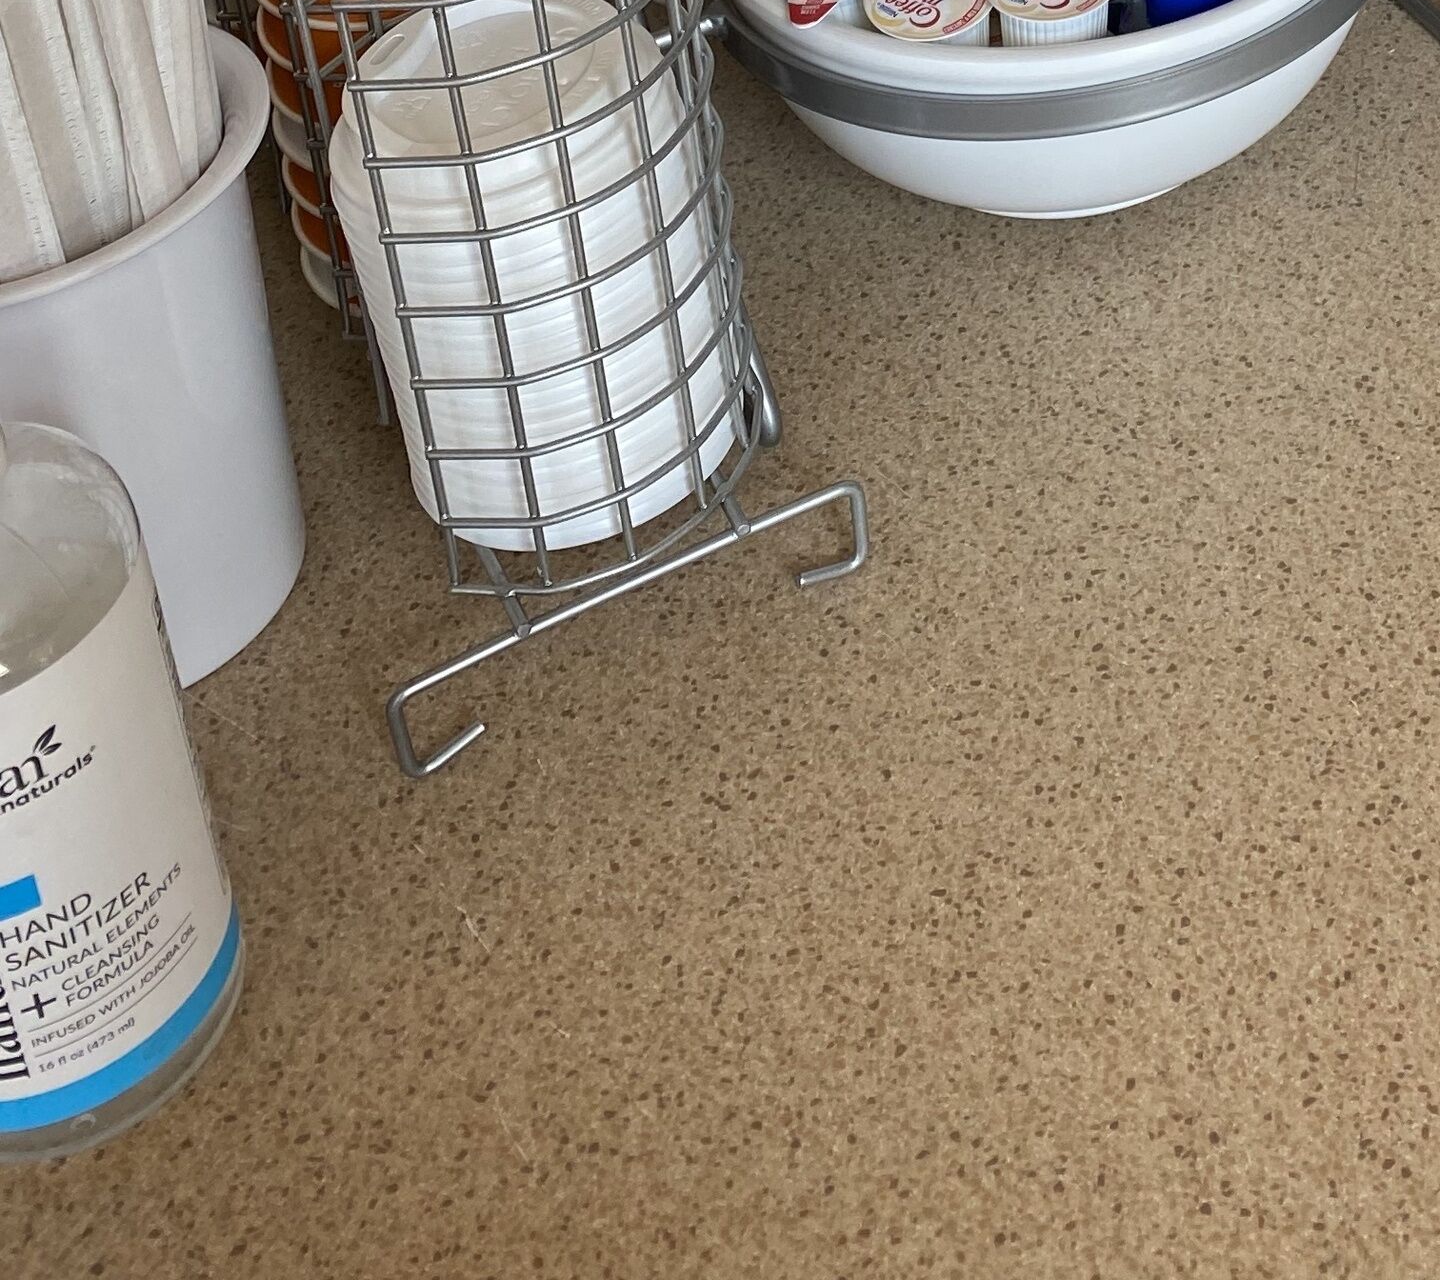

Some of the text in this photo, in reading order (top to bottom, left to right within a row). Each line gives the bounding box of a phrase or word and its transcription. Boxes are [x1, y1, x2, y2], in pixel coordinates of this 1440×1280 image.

[0, 892, 92, 949] HAND
[5, 871, 151, 972] SANITIZER
[11, 862, 182, 991] NATURAL ELEMENTS
[61, 913, 160, 991] CLEANSING
[31, 1014, 96, 1048] INFUSED
[98, 985, 136, 1017] WITH
[139, 943, 180, 989] JOJOBA
[66, 940, 154, 1007] FORMULA
[39, 1061, 56, 1073] 16
[70, 1049, 85, 1062] oz
[87, 1032, 116, 1054] (473
